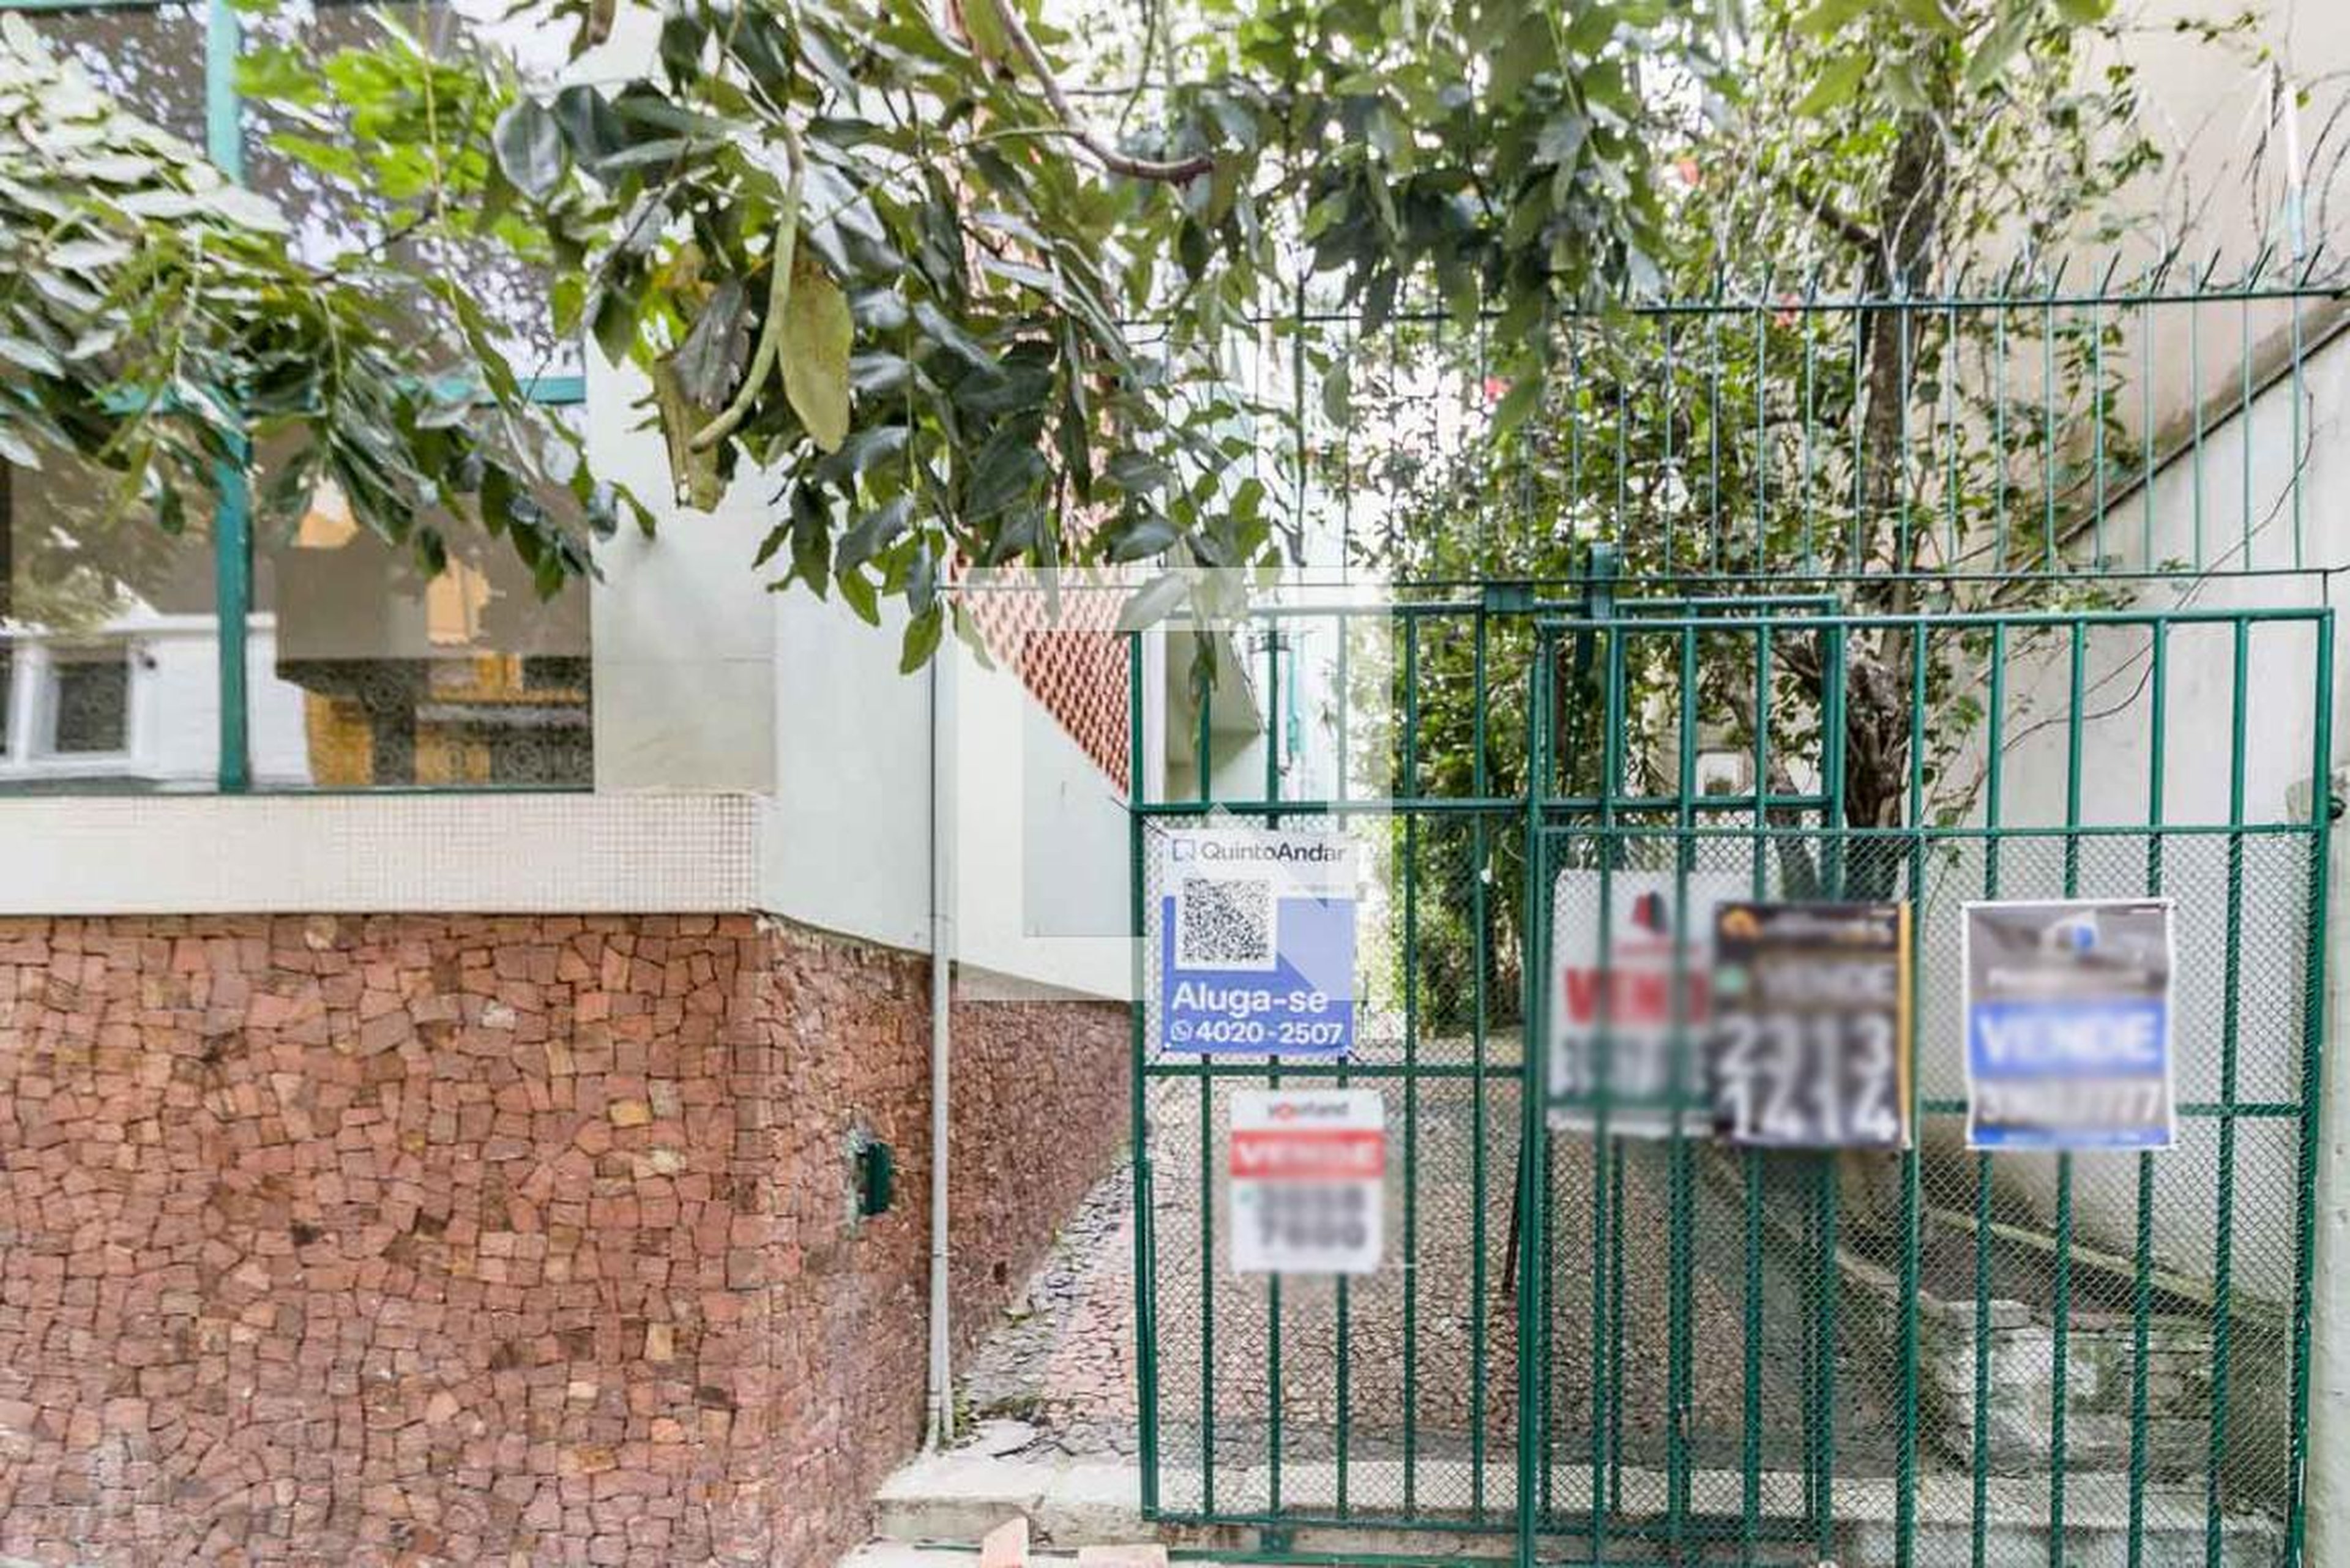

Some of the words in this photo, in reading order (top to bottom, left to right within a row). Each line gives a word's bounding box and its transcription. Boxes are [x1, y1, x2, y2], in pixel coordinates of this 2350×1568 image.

[1201, 841, 1347, 861] QuintoAndar
[1171, 980, 1328, 1018] Aluga-se
[1196, 1020, 1344, 1044] 4020-2507
